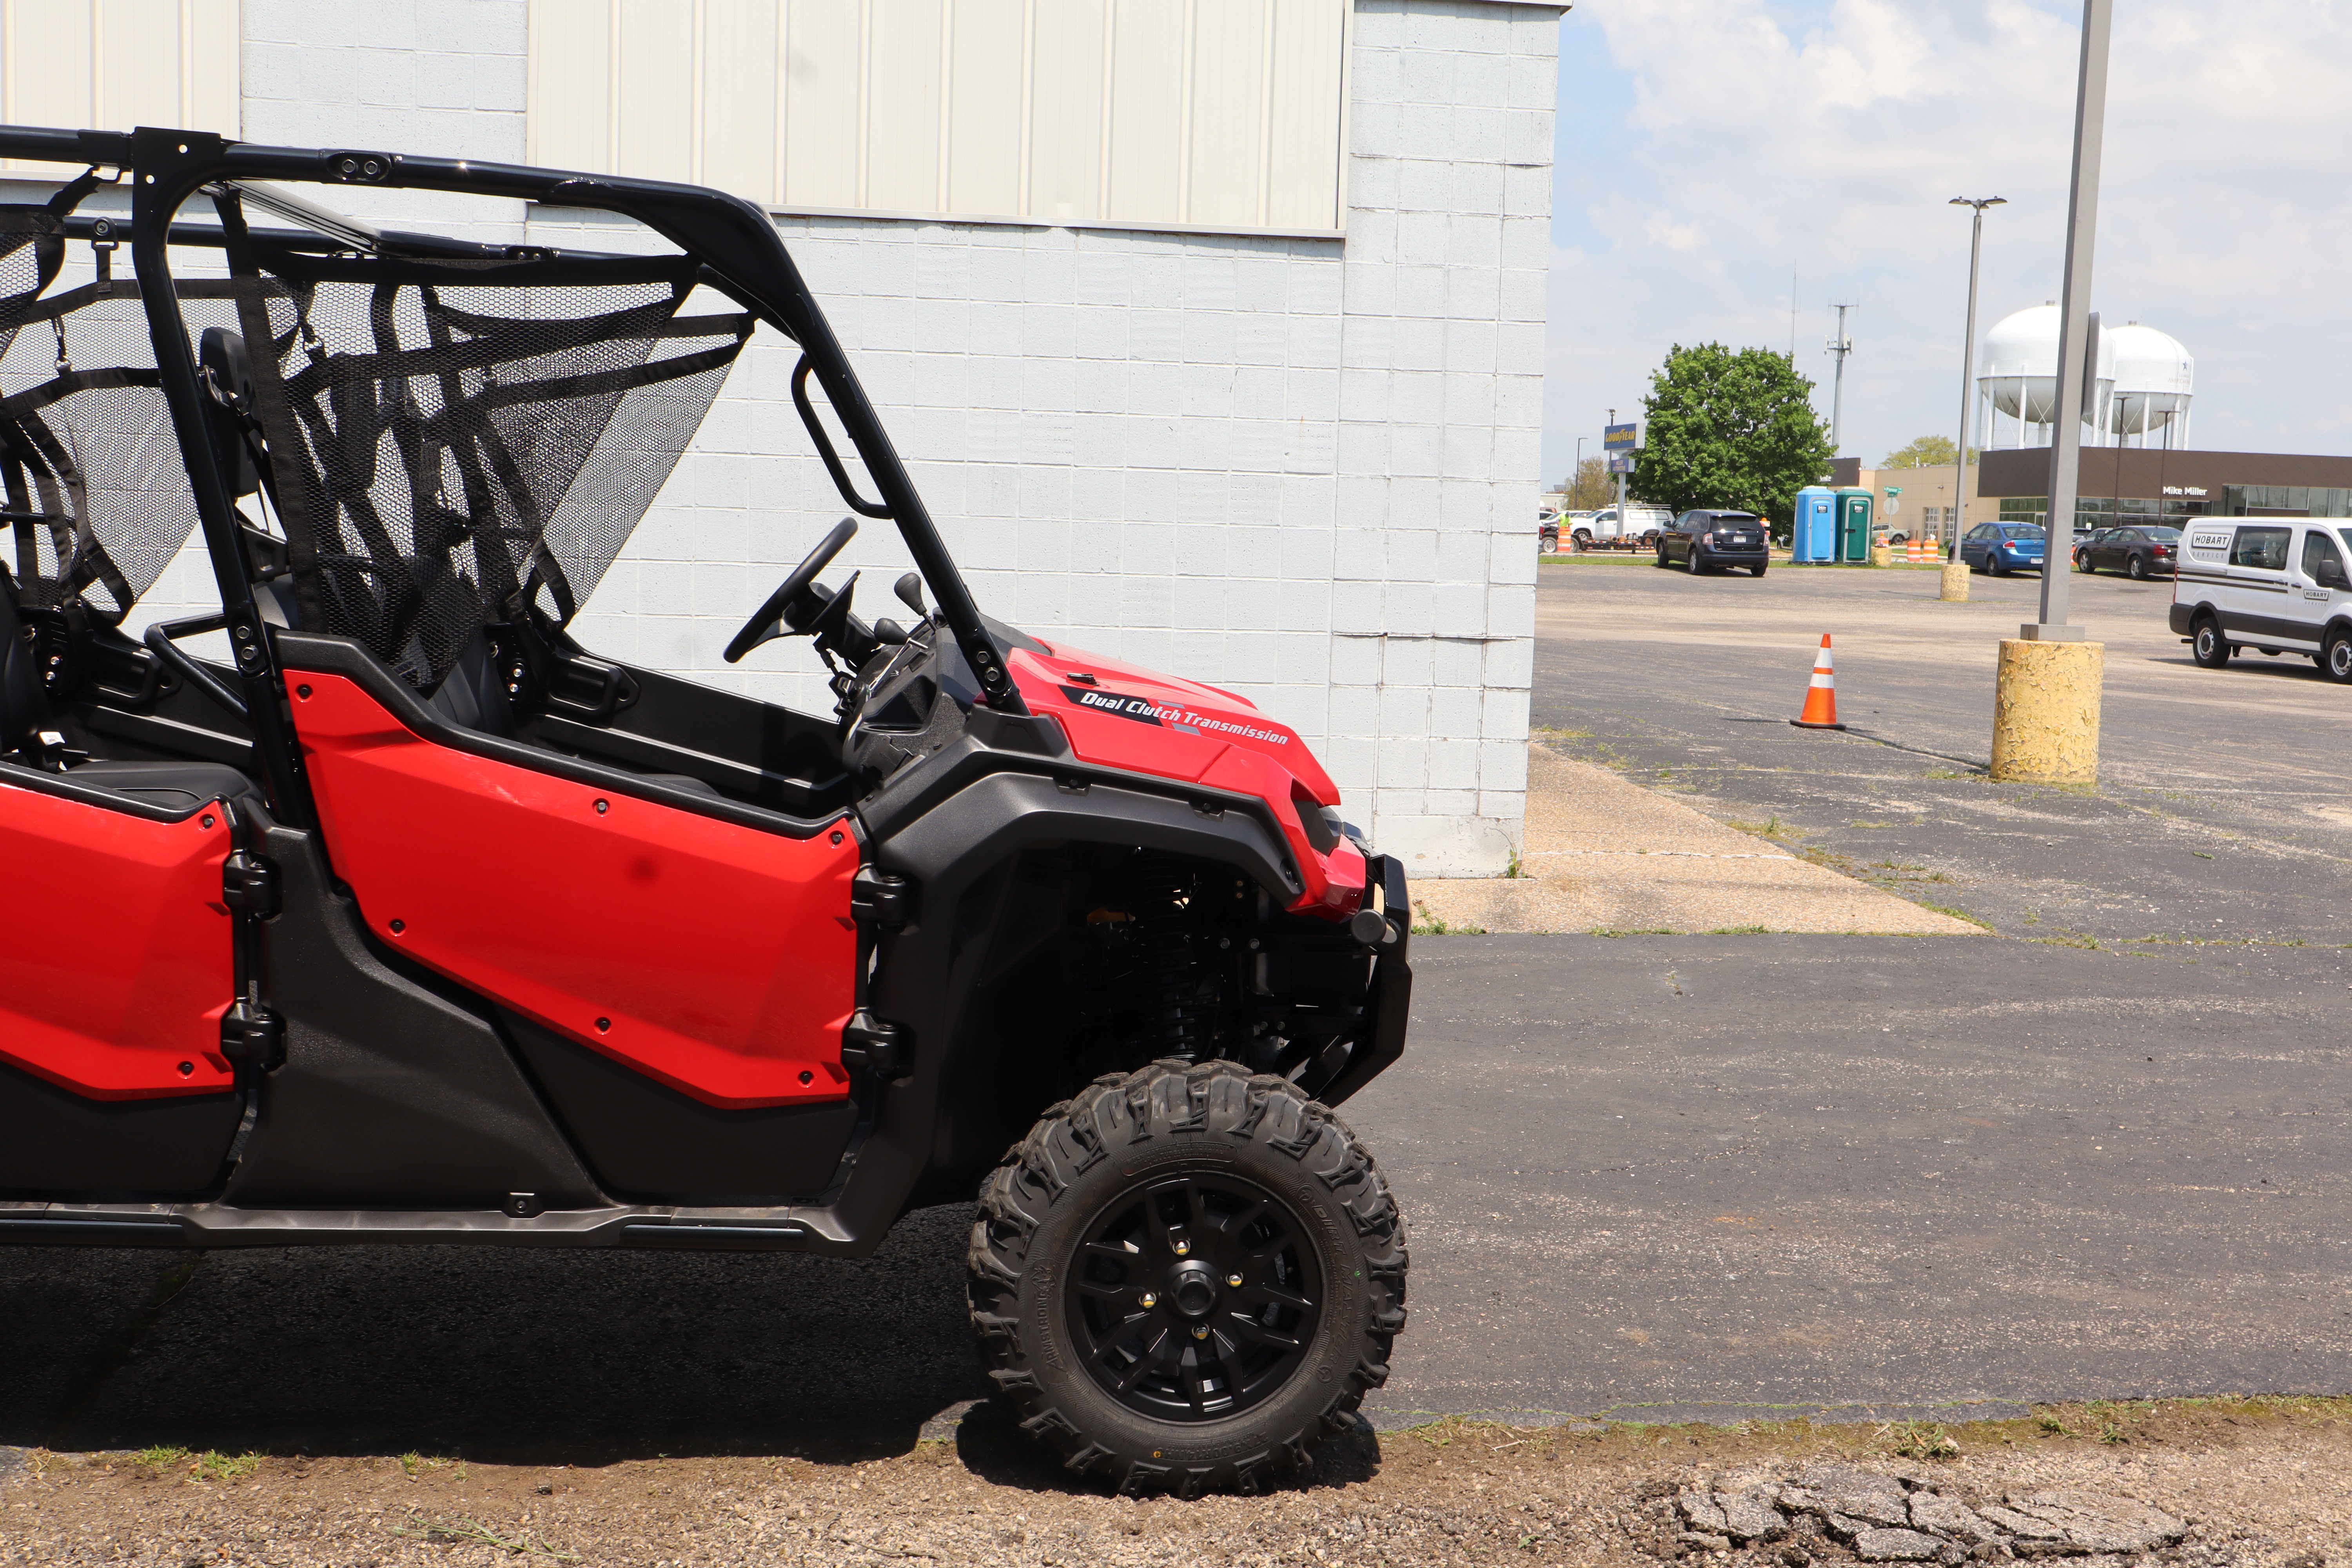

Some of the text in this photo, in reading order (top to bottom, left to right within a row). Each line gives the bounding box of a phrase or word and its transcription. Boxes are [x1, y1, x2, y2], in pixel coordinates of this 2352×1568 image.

[1606, 431, 1635, 442] GOODYEAR
[2163, 486, 2207, 495] Mike Miller
[2195, 535, 2227, 544] HOBART
[1080, 692, 1288, 745] Dual Clutch Transmission
[1313, 1205, 1347, 1256] DIRT
[1037, 1290, 1067, 1372] ARMSTRONG
[1328, 1264, 1353, 1365] MASTER
